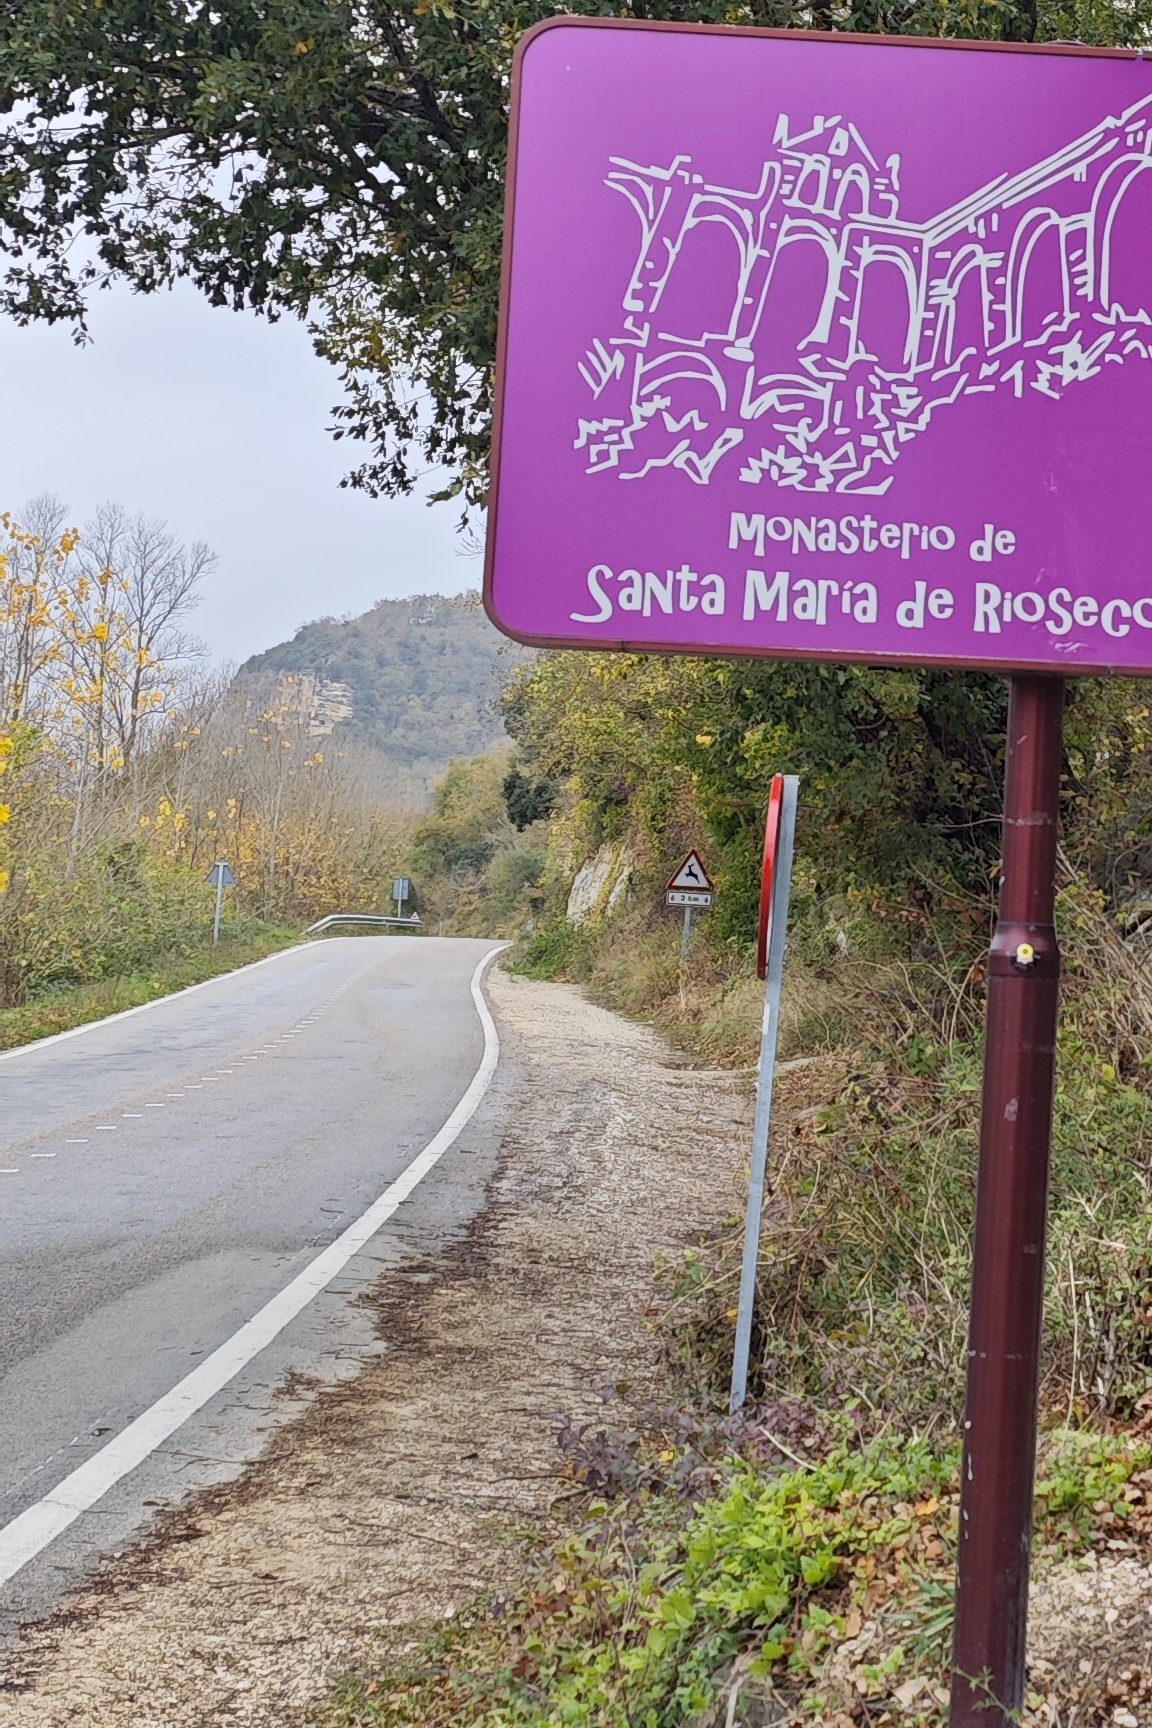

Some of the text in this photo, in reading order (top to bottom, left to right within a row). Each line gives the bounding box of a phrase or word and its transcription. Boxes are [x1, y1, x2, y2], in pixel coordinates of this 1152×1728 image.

[728, 512, 1017, 562] Monasterio de
[570, 564, 725, 624] Santa
[742, 569, 879, 627] María
[895, 580, 955, 629] de
